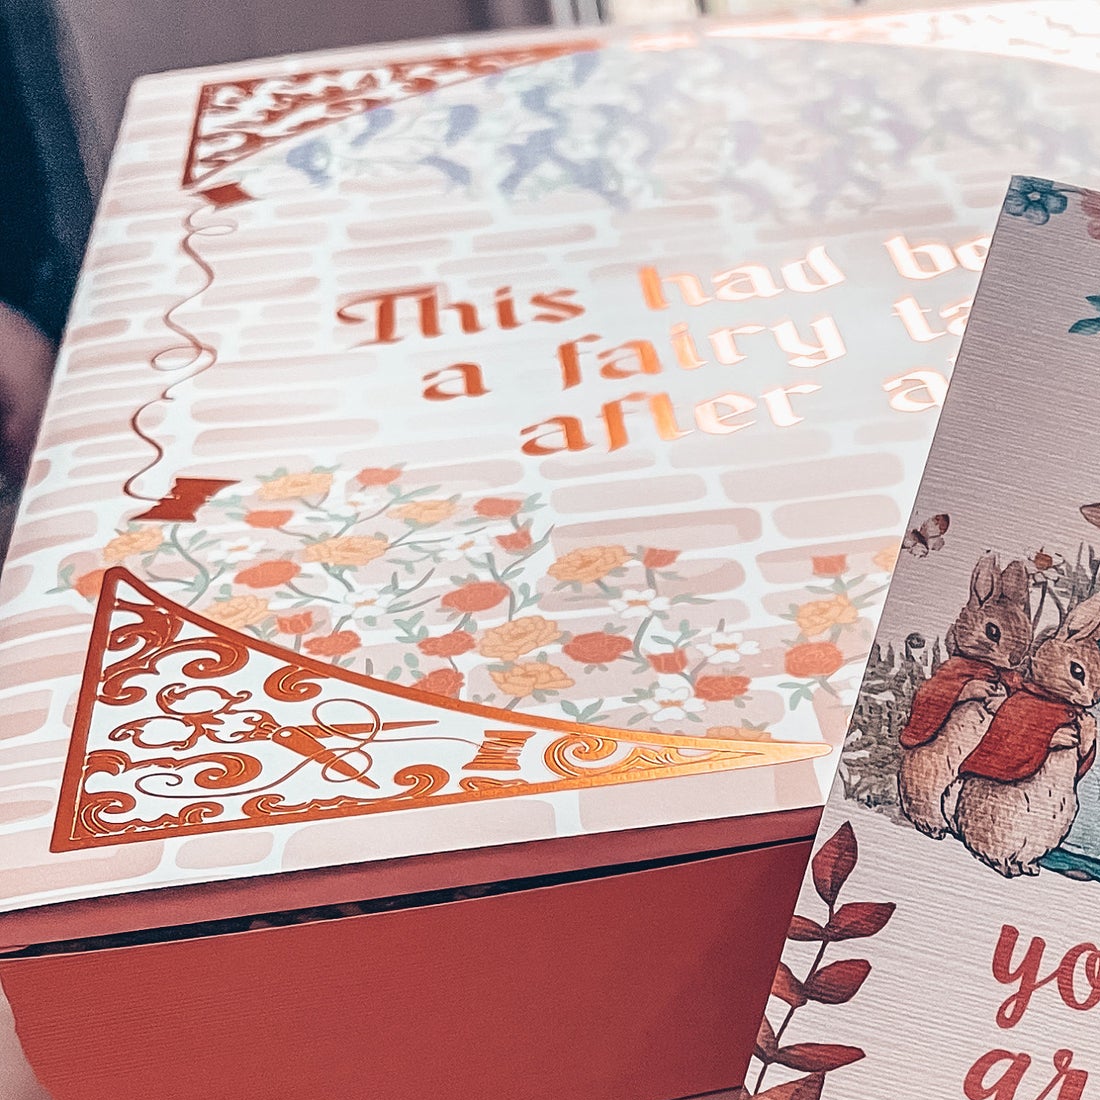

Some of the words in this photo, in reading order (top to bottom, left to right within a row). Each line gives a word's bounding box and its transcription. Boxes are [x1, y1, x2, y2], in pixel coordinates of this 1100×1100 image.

[336, 283, 586, 350] This
[638, 246, 846, 310] had
[422, 362, 491, 401] a
[555, 316, 847, 390] fairy
[519, 381, 823, 455] after
[882, 356, 957, 412] a
